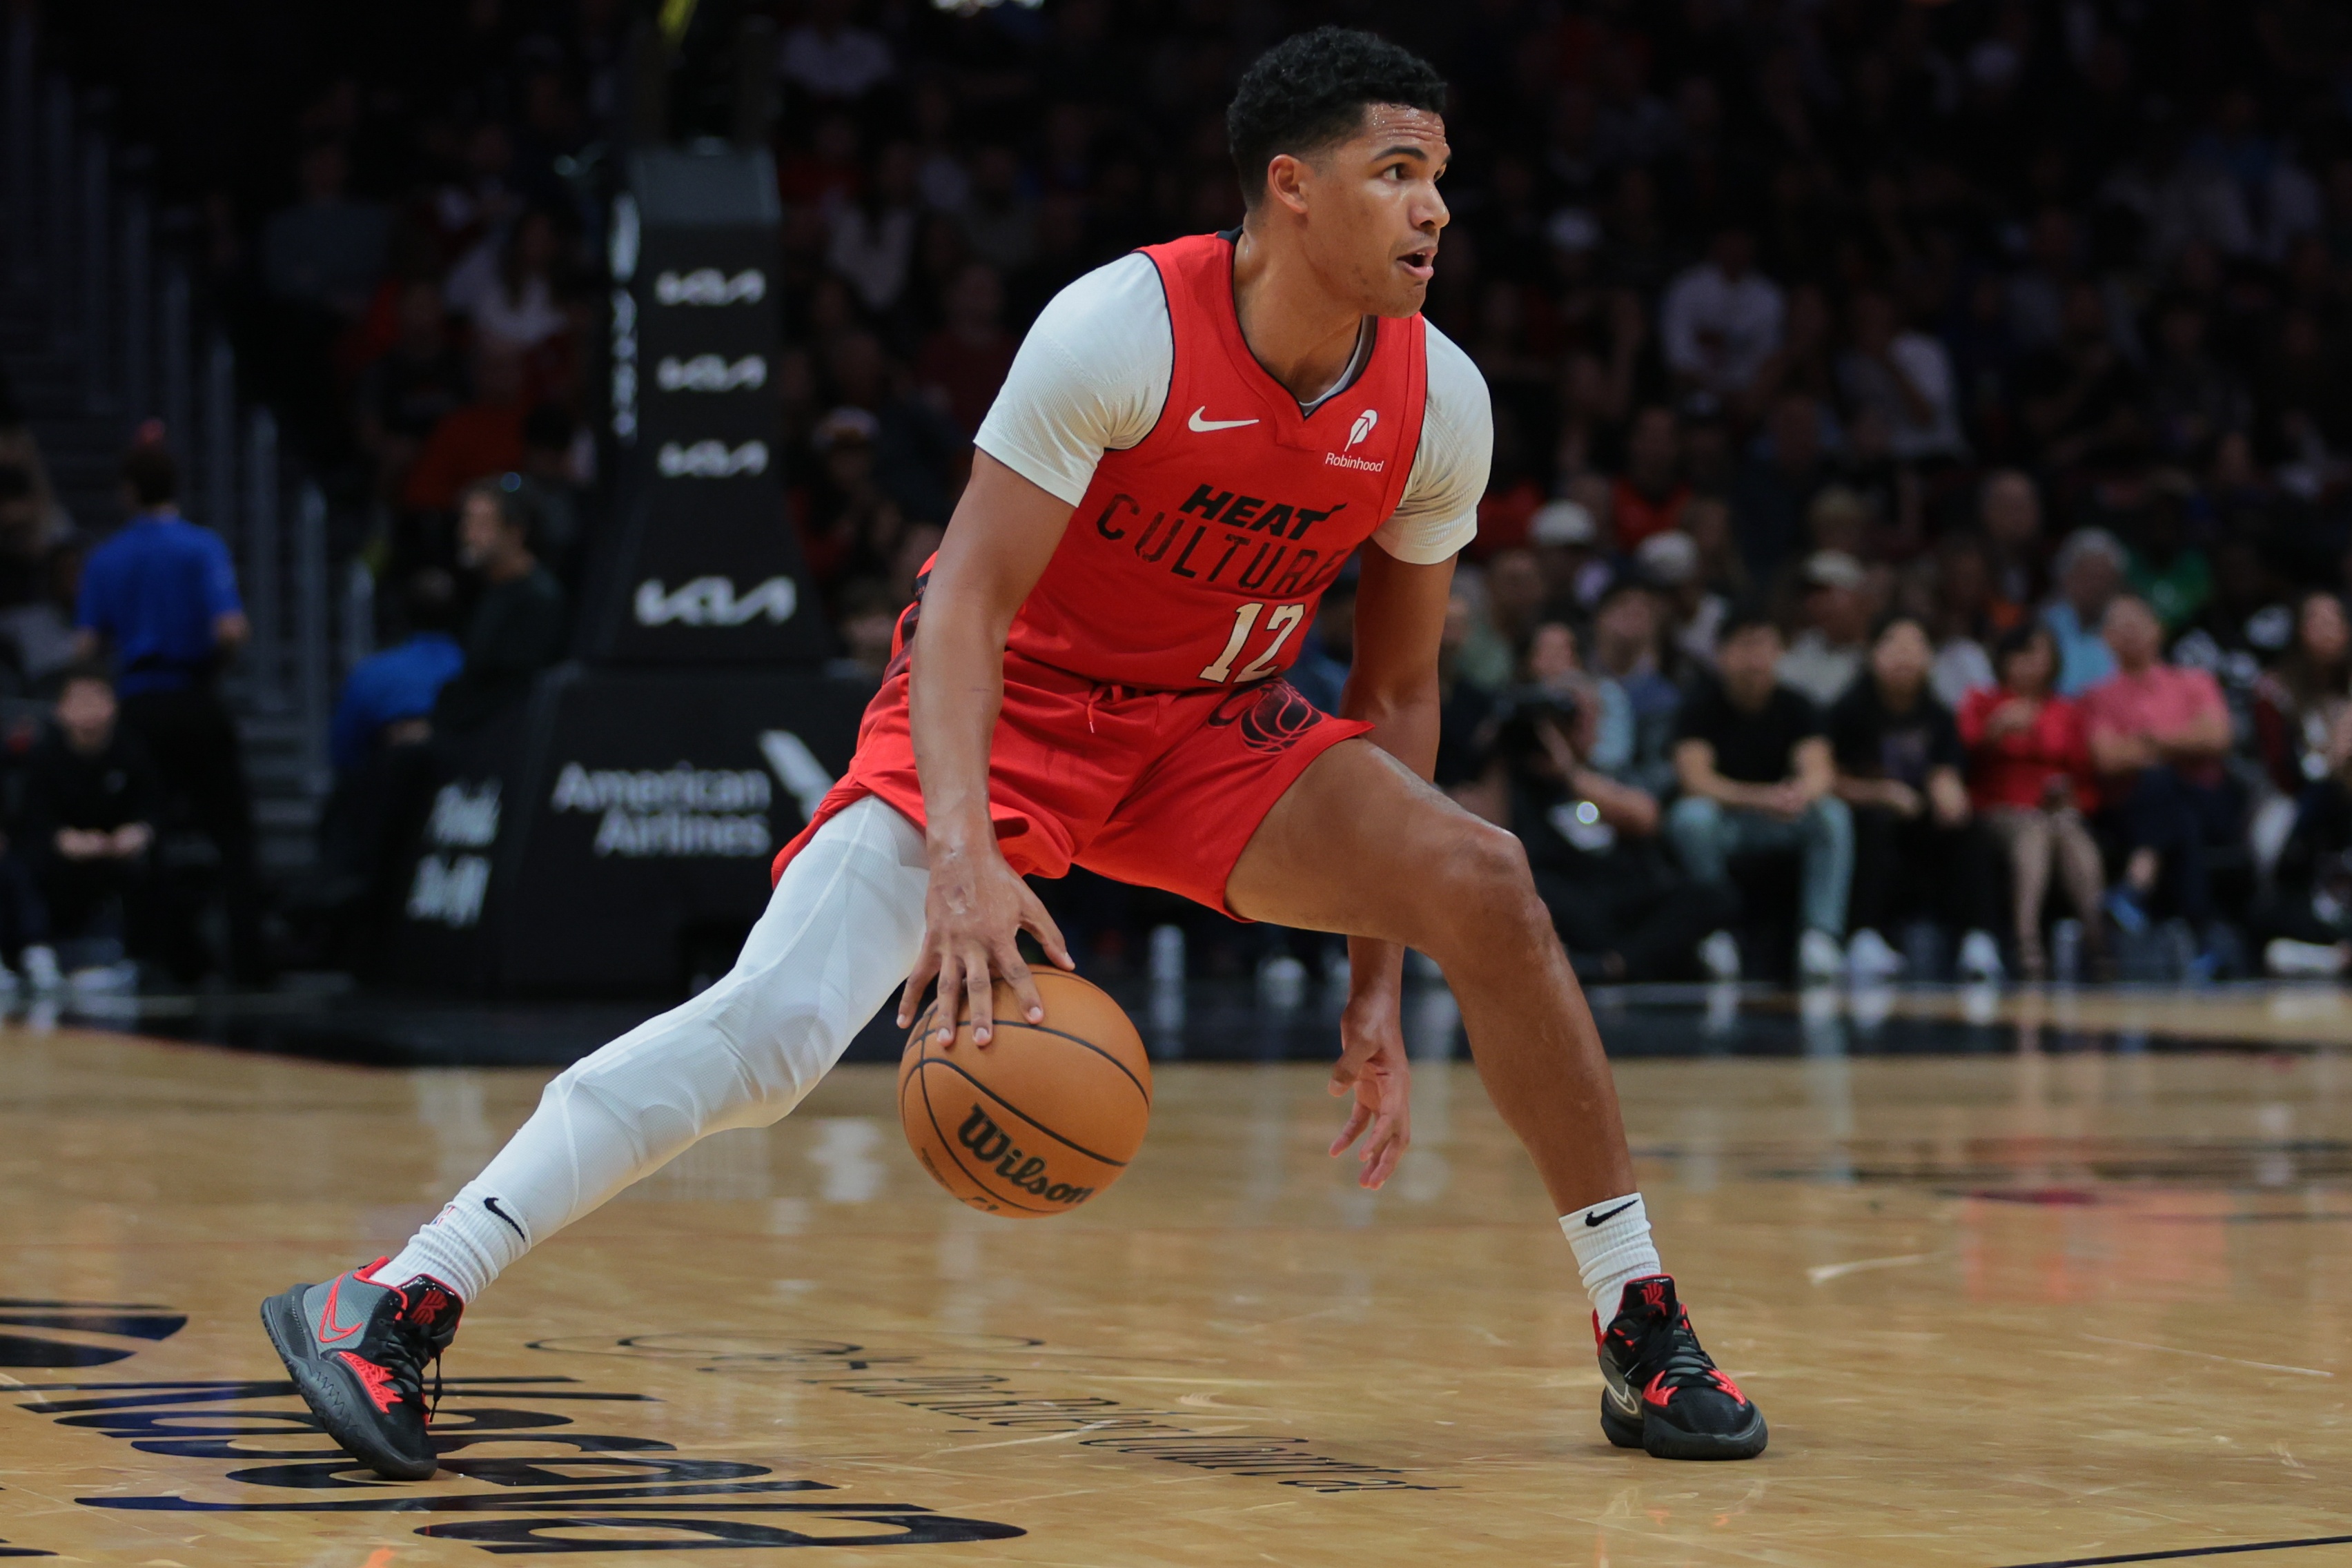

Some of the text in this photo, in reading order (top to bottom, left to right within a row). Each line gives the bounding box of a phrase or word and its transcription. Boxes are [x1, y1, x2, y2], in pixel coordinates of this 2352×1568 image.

[1325, 452, 1384, 473] Robinhood
[1179, 484, 1349, 540] HEAT
[634, 574, 797, 628] KIA
[1199, 602, 1306, 683] 12
[550, 761, 772, 814] American
[591, 803, 774, 859] Airlines
[958, 1104, 1095, 1203] Wilson
